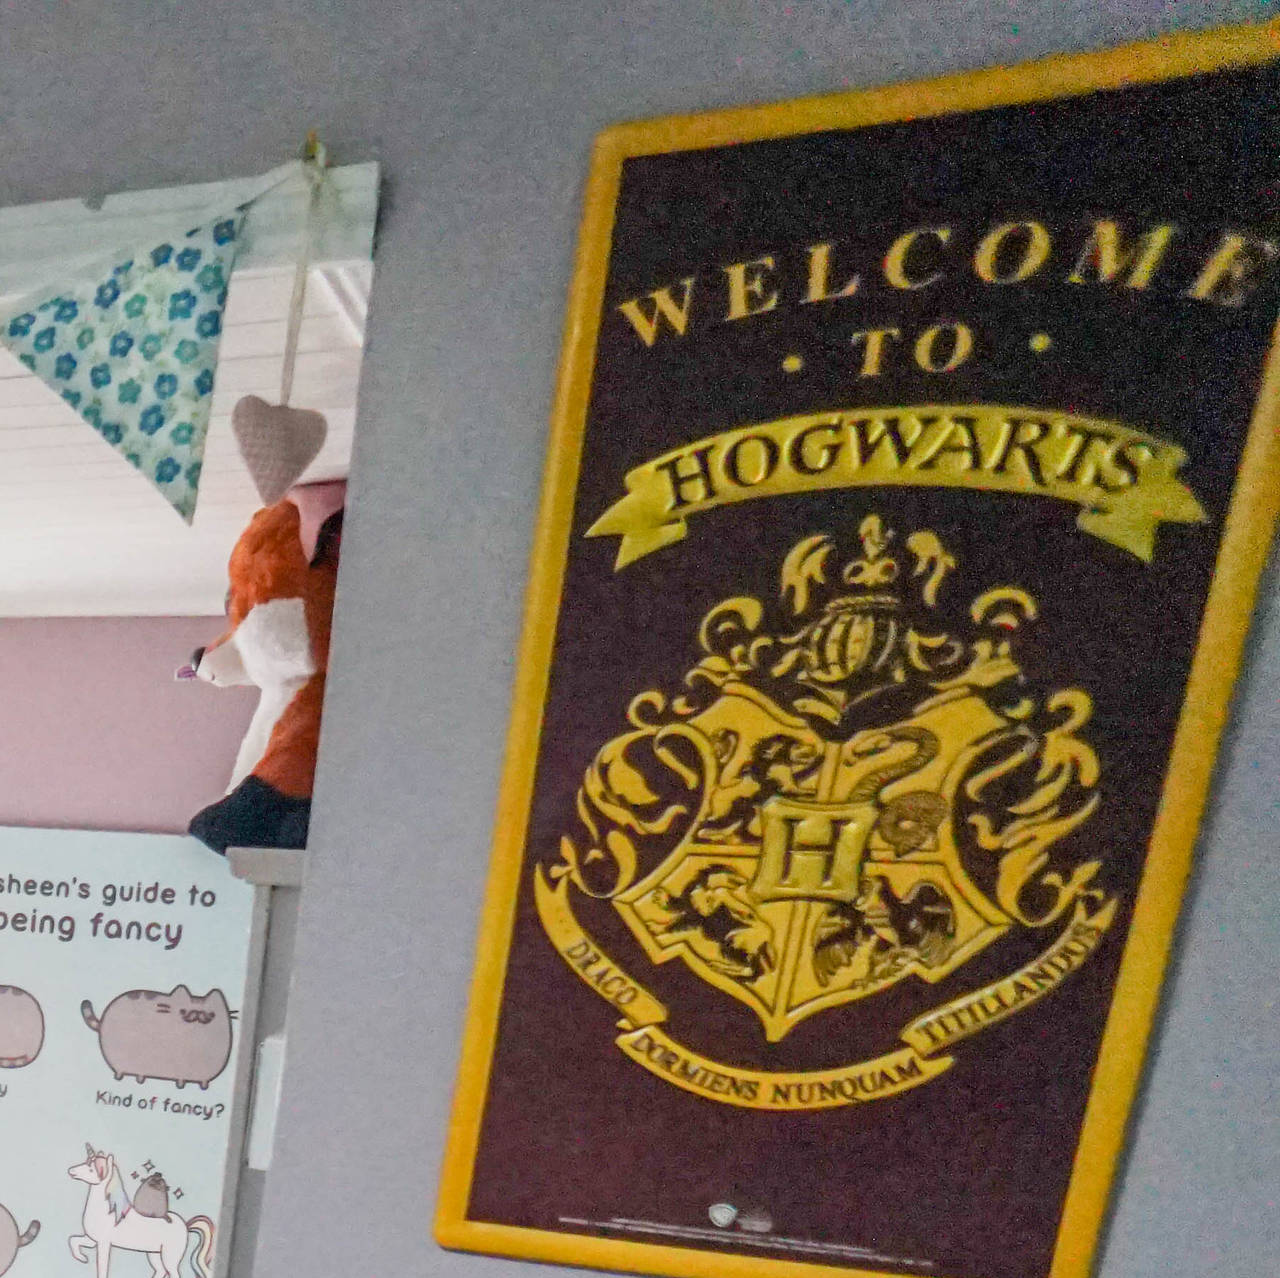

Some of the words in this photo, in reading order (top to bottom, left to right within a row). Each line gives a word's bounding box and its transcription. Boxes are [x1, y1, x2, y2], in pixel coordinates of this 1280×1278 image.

[618, 218, 1278, 348] WELCOME
[851, 322, 973, 377] TO
[655, 414, 1149, 513] HOGWARTS
[776, 816, 855, 888] H
[102, 881, 176, 907] guide
[188, 884, 217, 907] to
[90, 911, 183, 951] fancy
[566, 940, 638, 1005] DRACO
[631, 1032, 760, 1102] DORMIENS
[770, 1055, 924, 1104] NUNQUAM
[95, 1090, 133, 1108] Kind
[137, 1096, 158, 1110] of
[163, 1097, 225, 1121] fancy?
